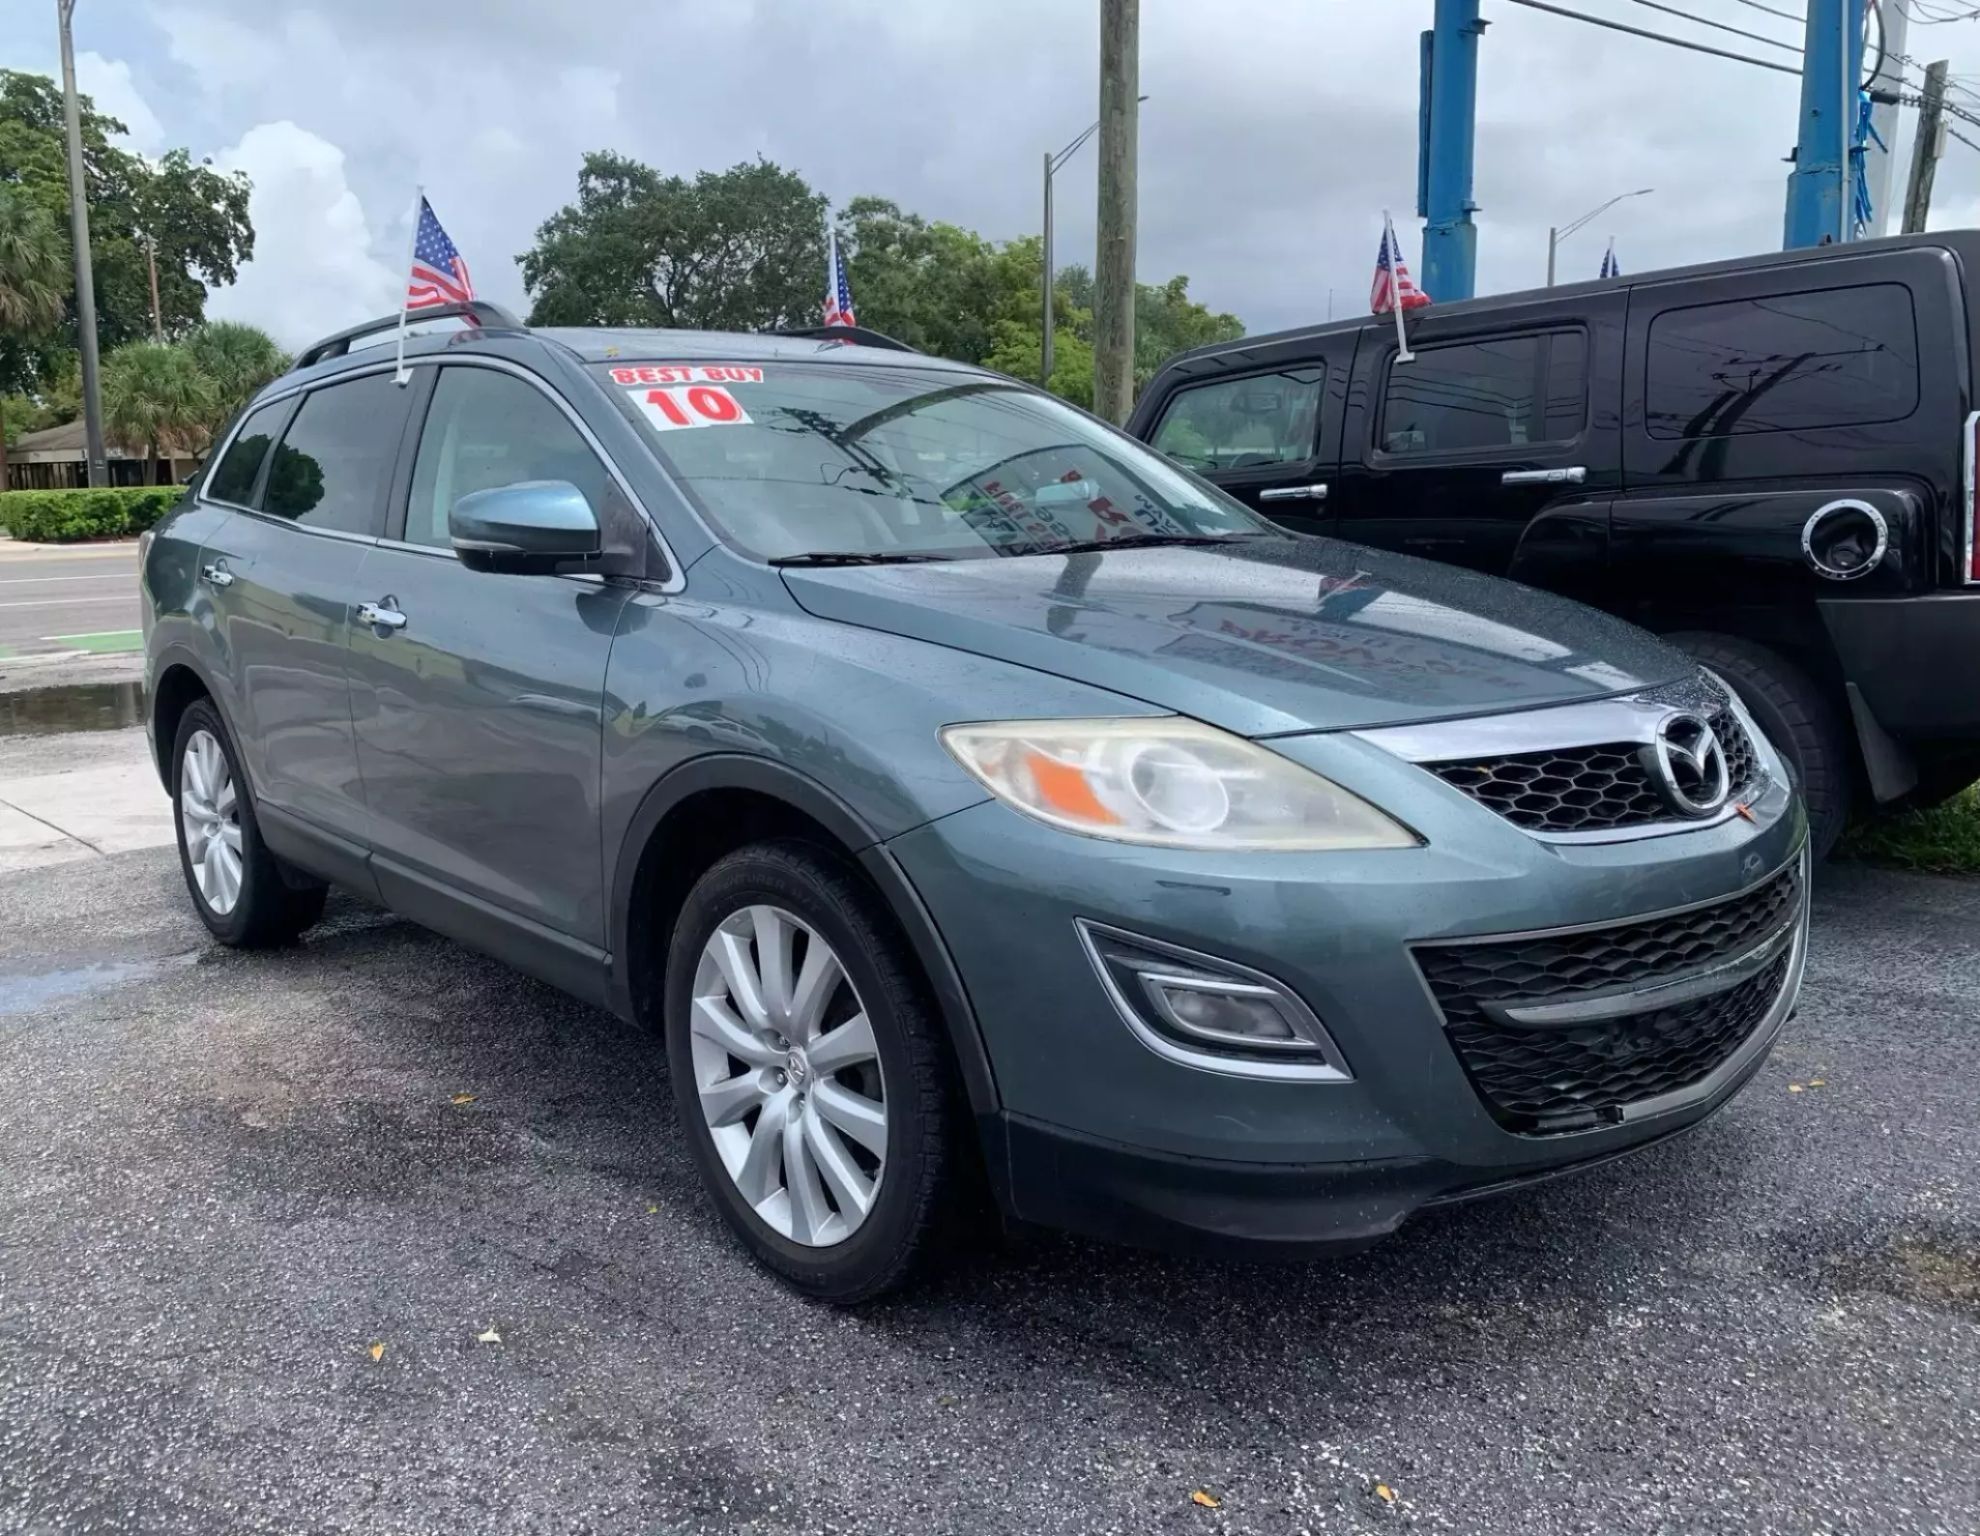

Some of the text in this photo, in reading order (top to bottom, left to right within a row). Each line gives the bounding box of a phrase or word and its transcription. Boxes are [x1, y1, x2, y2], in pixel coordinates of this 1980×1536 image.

[611, 367, 763, 384] BEST BUY
[646, 385, 742, 426] 10
